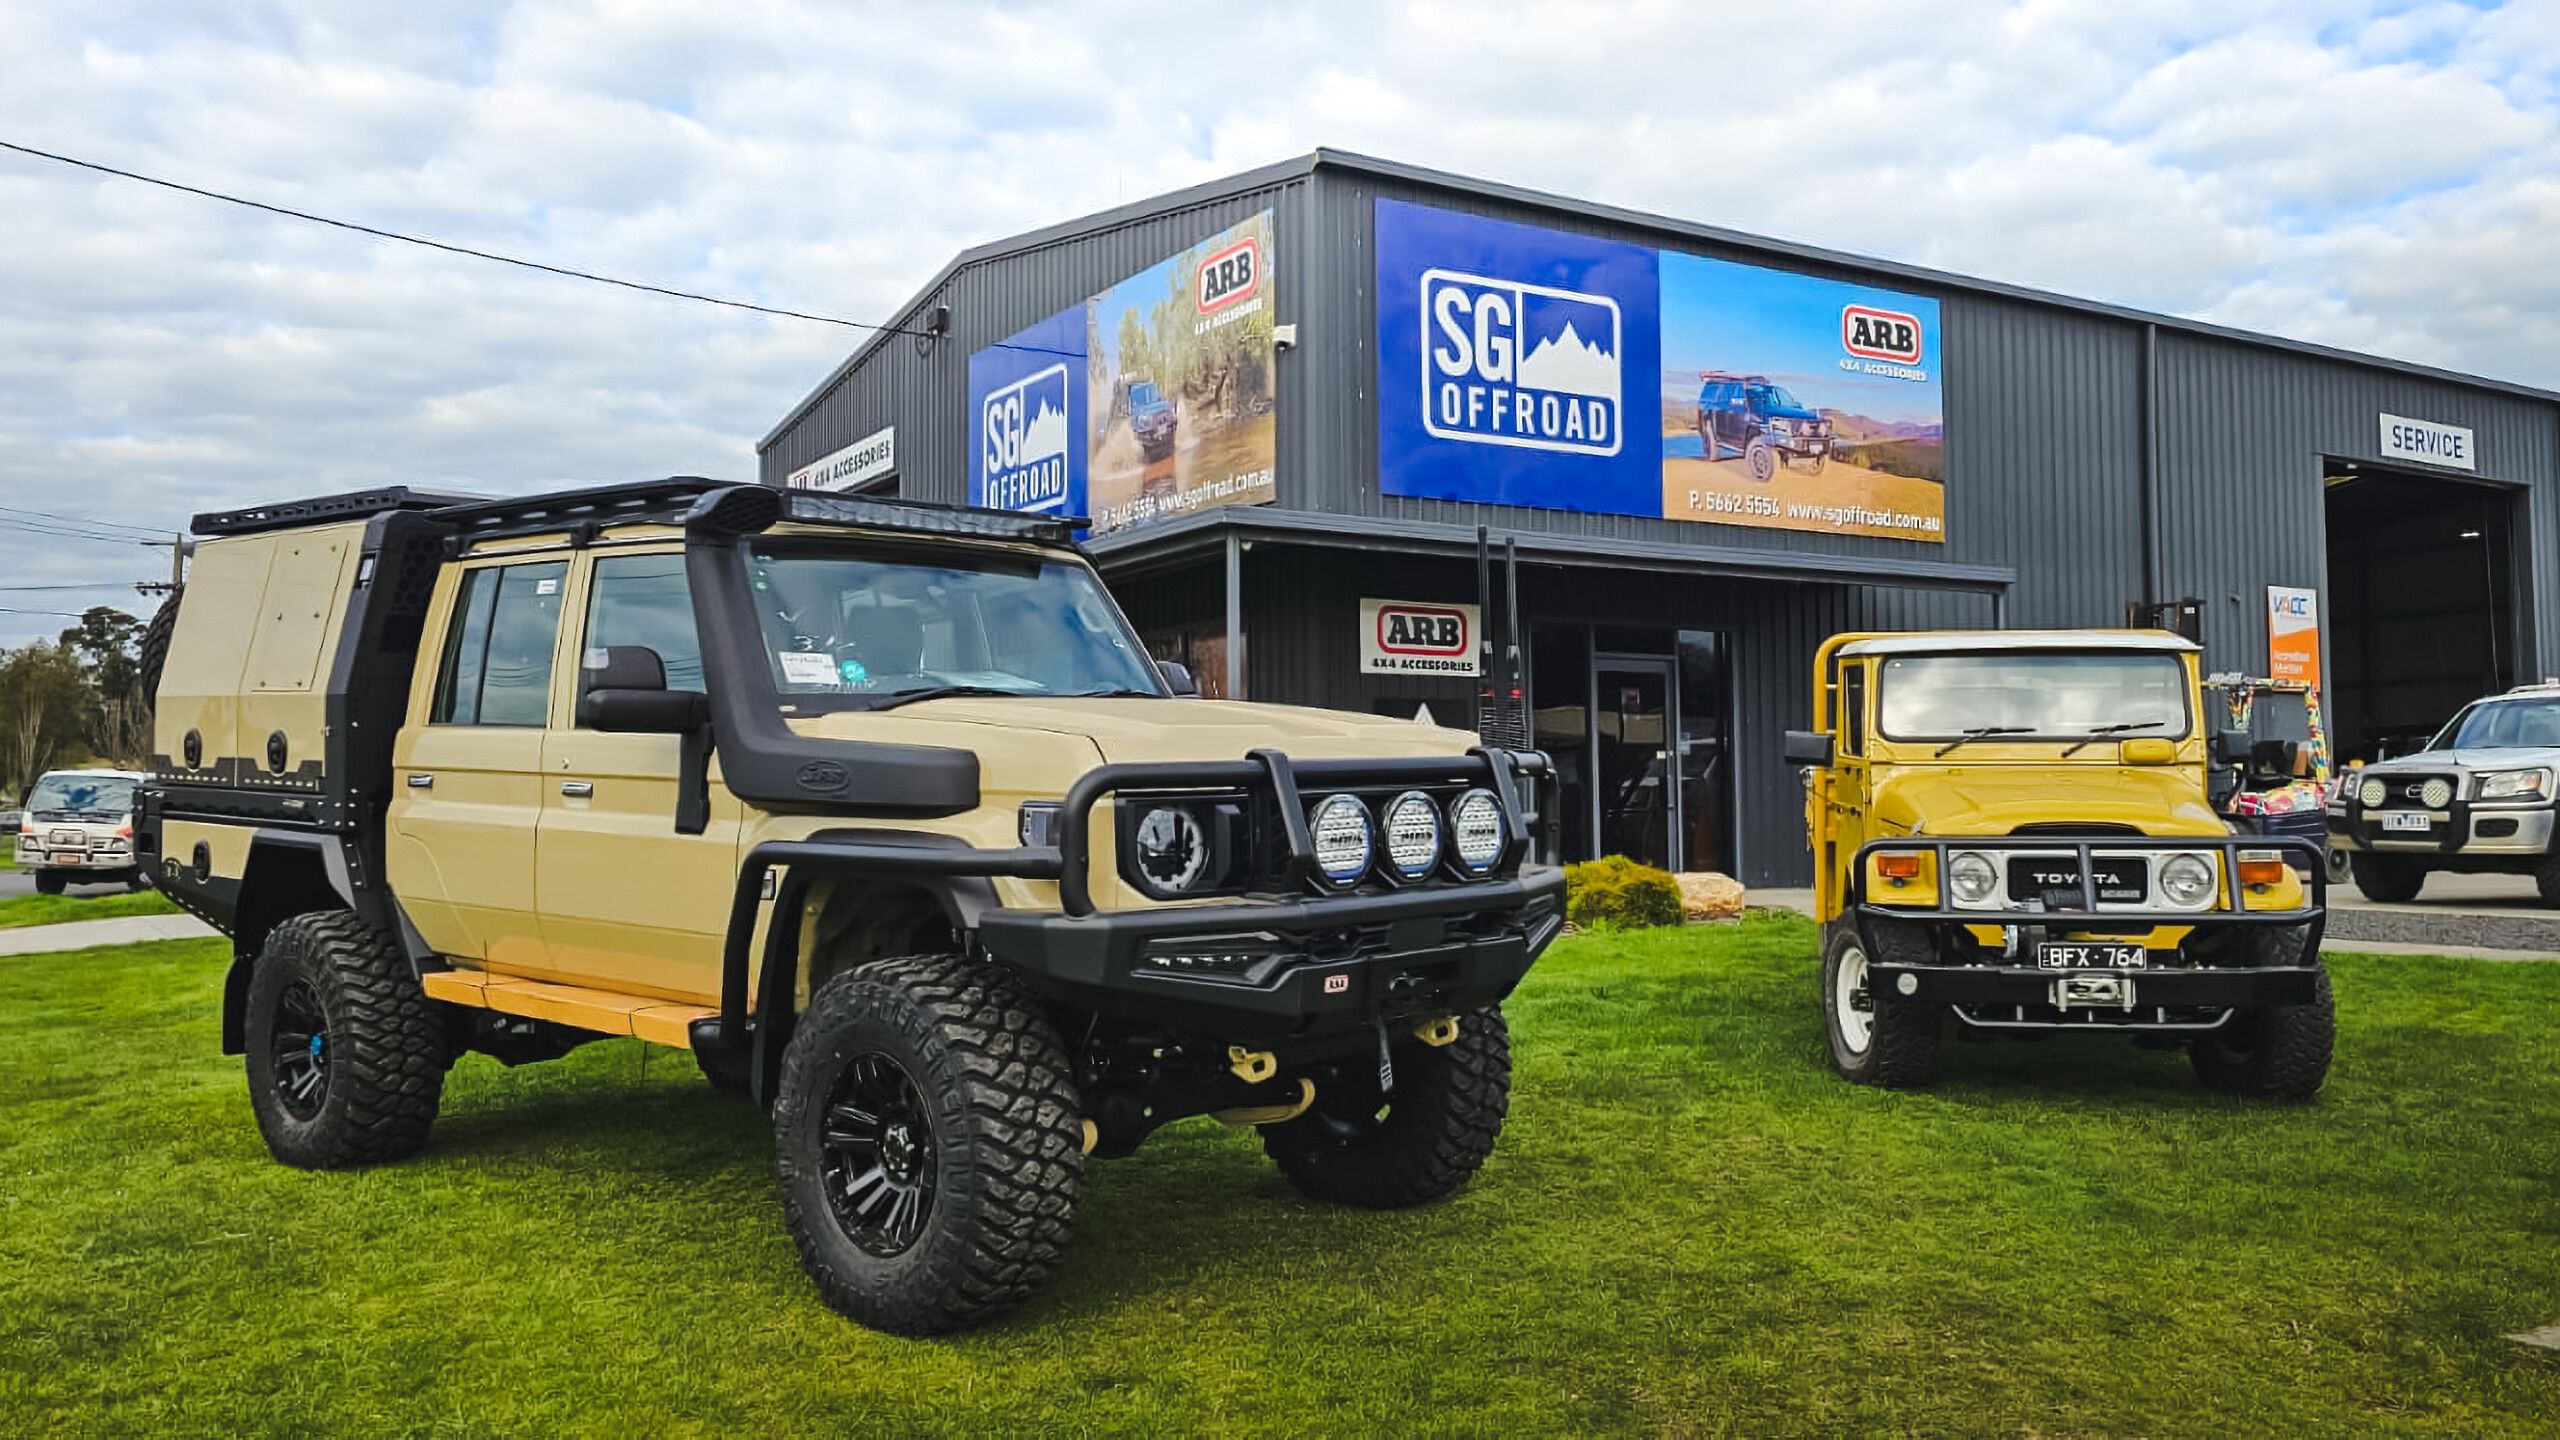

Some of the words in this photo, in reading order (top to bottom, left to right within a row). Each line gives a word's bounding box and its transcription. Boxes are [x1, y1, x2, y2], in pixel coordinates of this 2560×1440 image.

[1204, 252, 1251, 302] ARB
[1435, 287, 1512, 382] SG
[1852, 316, 1913, 352] ARB
[1442, 383, 1606, 441] OFFROAD
[988, 397, 1019, 474] SG
[2393, 424, 2464, 458] SERVICE
[833, 440, 890, 482] ACCESSORIES
[989, 459, 1061, 511] OFFROAD
[1689, 490, 1702, 510] P.
[1706, 492, 1742, 513] 5662
[1746, 496, 1780, 518] 5554
[1387, 615, 1459, 647] ARB
[1400, 659, 1474, 671] ACCESSORIES
[2033, 873, 2121, 884] TOYTA
